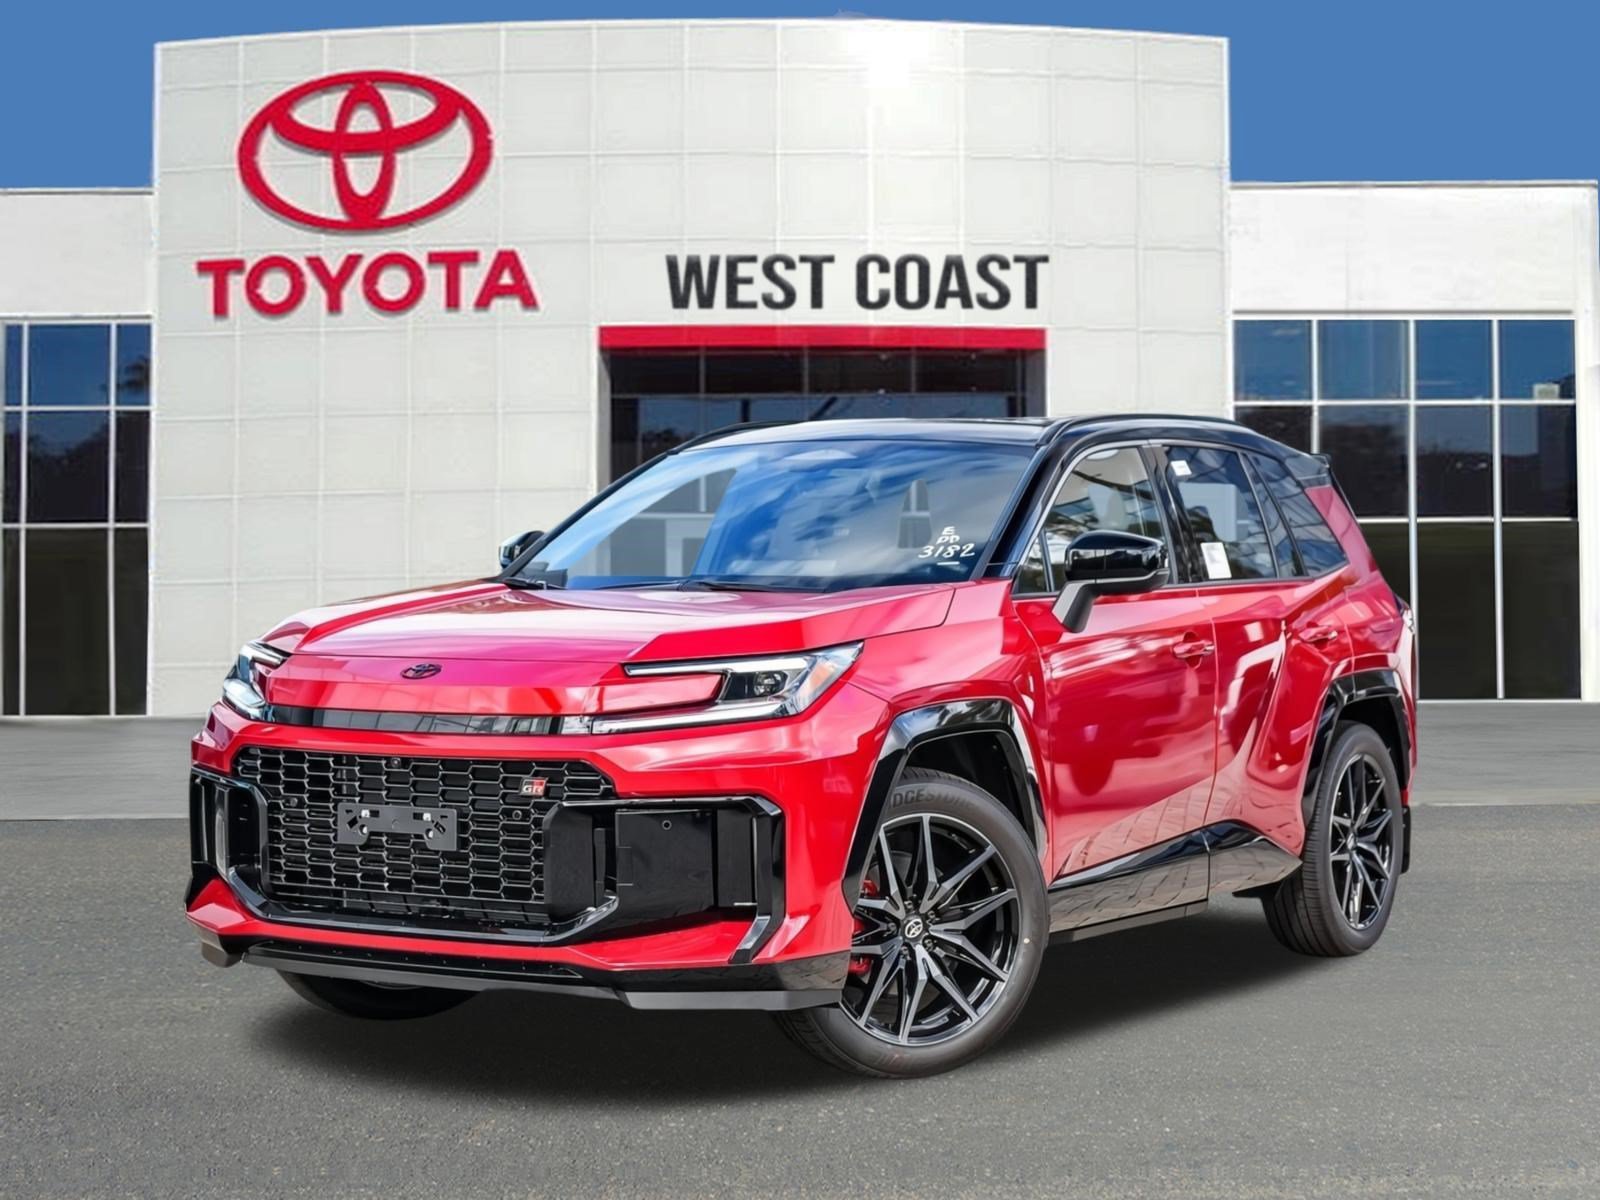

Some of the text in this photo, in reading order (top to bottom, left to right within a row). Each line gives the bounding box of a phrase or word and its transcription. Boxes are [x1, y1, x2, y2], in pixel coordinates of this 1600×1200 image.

[196, 250, 538, 317] TOYOTA
[666, 254, 1049, 309] WEST COAST
[918, 543, 975, 558] 3182
